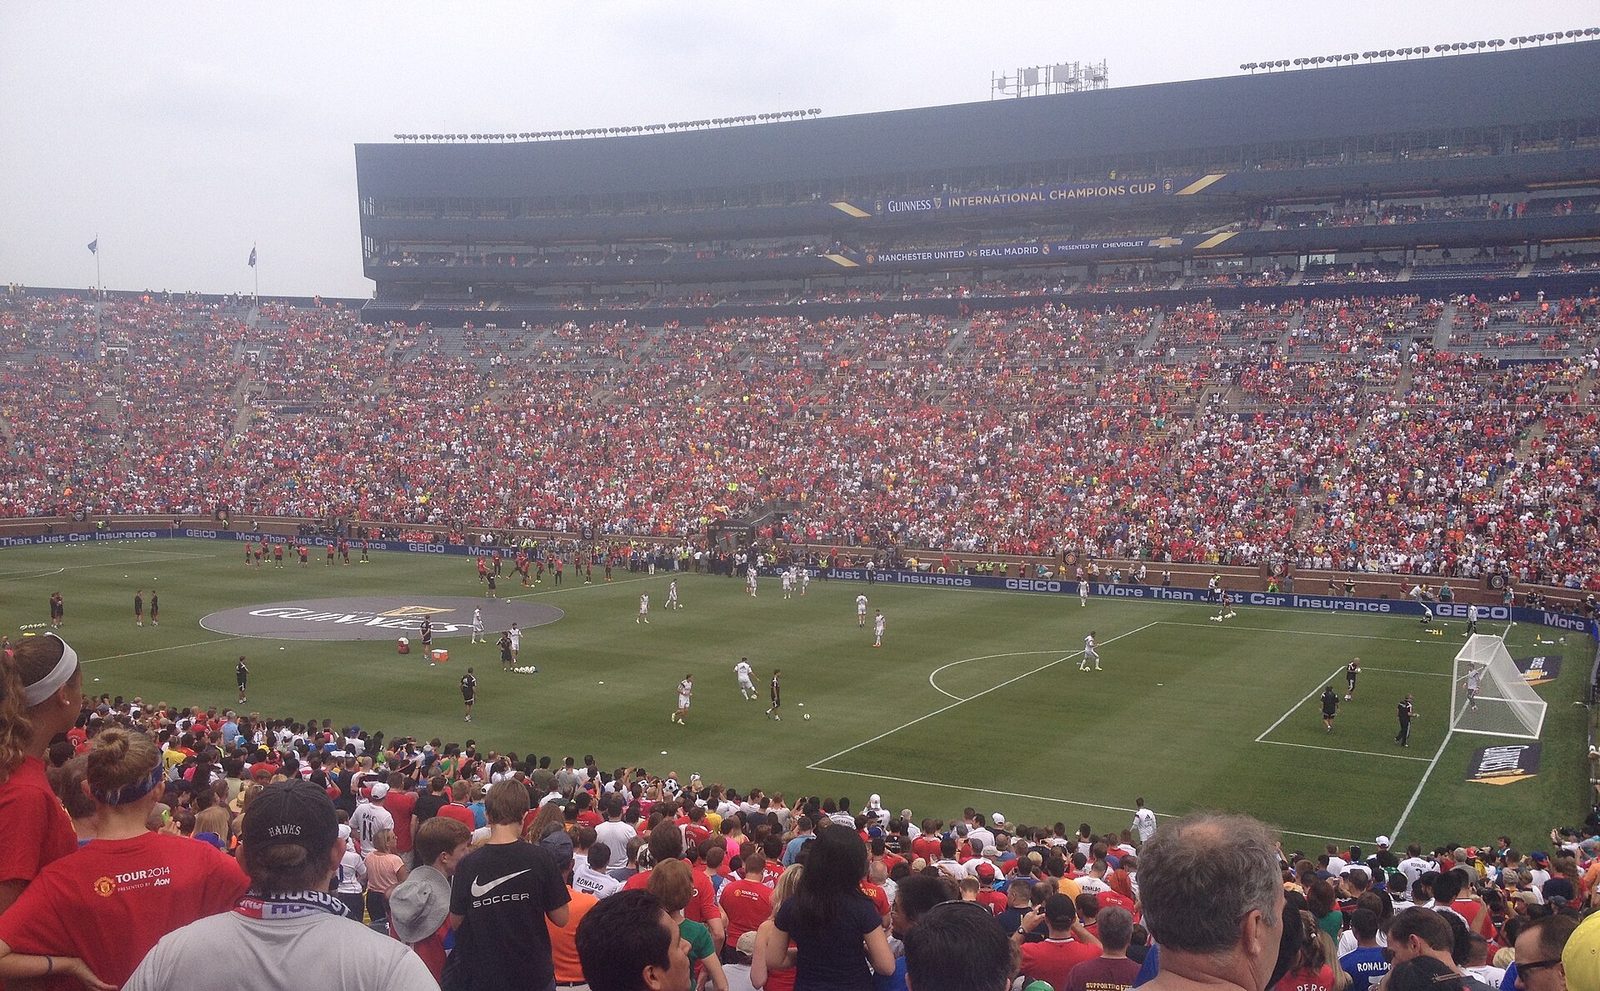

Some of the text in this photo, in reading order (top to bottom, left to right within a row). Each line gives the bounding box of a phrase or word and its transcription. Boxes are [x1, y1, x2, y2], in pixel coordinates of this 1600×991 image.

[888, 183, 1156, 213] GUINNESS INTERNATIONAL CHAMPIONS CUP
[878, 252, 932, 262] MANCHESTER
[934, 250, 965, 260] UNITED
[979, 248, 1002, 257] REAL
[1004, 246, 1039, 256] MADRID
[1057, 243, 1090, 252] PRESENTED
[1090, 242, 1099, 250] BY
[1102, 240, 1145, 250] CHEVROLET
[0, 531, 157, 547] Than Just Car Insurance
[186, 528, 217, 539] GEICO
[235, 532, 261, 542] More
[408, 543, 445, 554] GEICO
[827, 567, 860, 580] Just
[897, 572, 972, 587] Insurance
[1005, 578, 1061, 593] GEICO
[1098, 584, 1144, 598] More
[1150, 587, 1194, 601] Than
[1250, 592, 1286, 606] Car
[1293, 595, 1391, 613] Insurance
[1436, 603, 1509, 620] GECO
[1543, 612, 1585, 631] More
[268, 823, 302, 838] HAWKS
[115, 866, 171, 884] TOUR 2014
[576, 876, 605, 892] RONALDO
[472, 892, 530, 909] SOCCER
